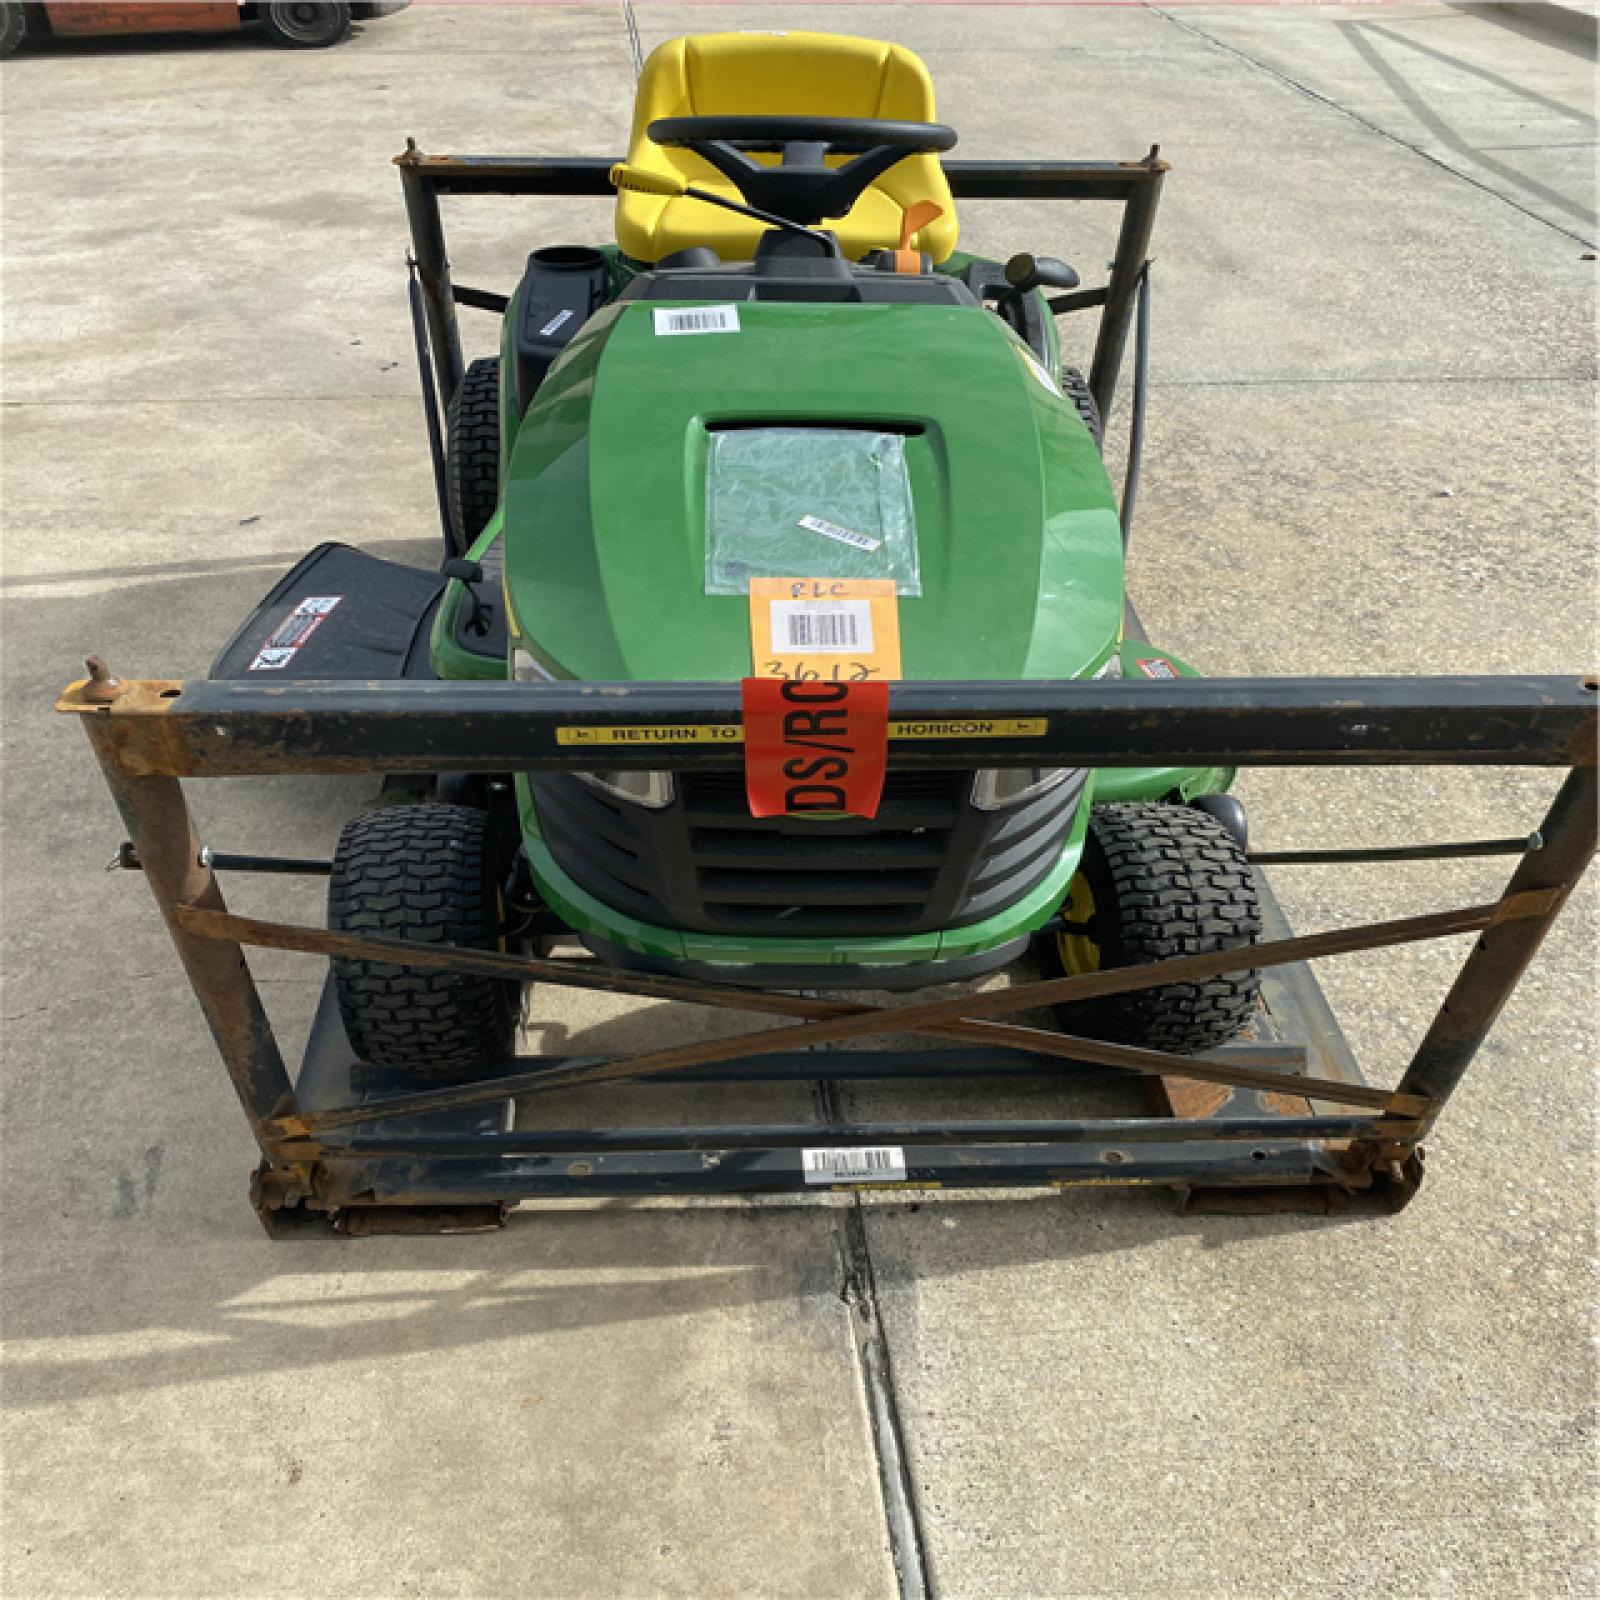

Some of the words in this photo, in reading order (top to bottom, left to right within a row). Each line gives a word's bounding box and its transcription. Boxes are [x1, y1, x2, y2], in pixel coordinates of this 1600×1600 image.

[611, 728, 697, 741] RETURN
[710, 727, 738, 739] TO
[896, 722, 994, 736] HORICON
[781, 680, 855, 812] DS/RC
